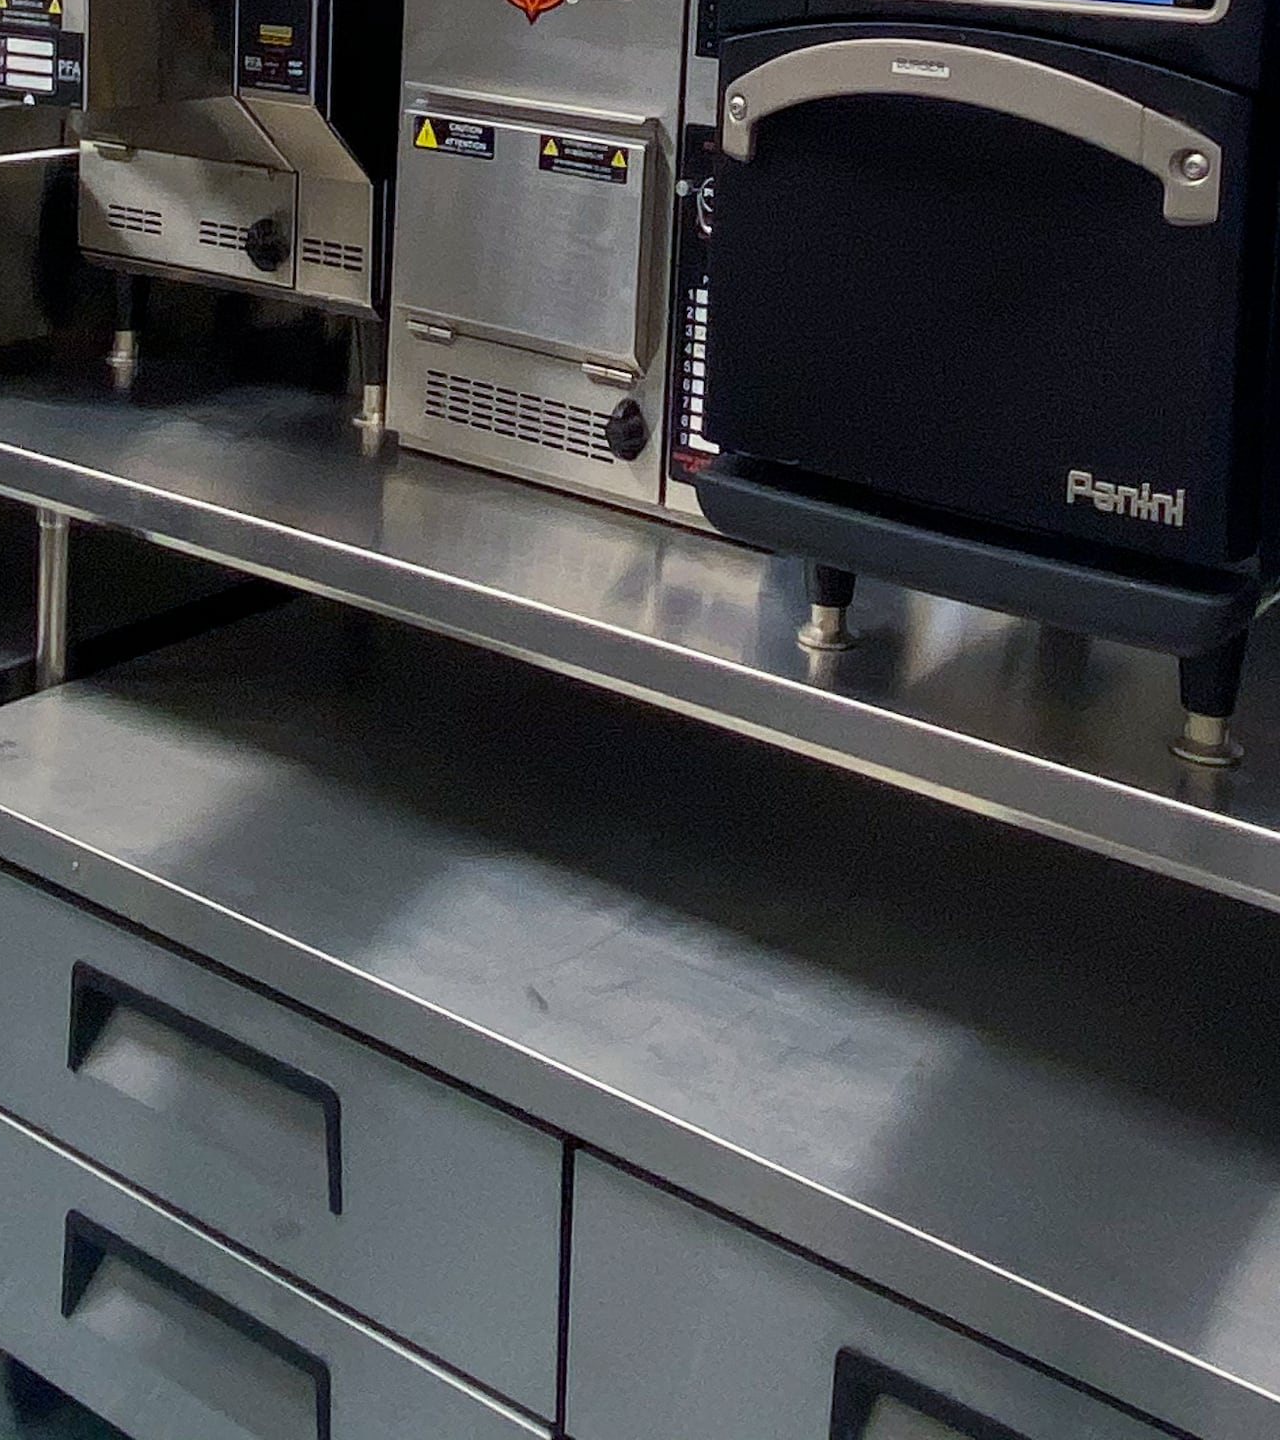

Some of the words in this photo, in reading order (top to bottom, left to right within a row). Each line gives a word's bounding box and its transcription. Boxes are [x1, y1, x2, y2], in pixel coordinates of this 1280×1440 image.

[687, 288, 694, 300] 1
[686, 305, 694, 319] 2
[685, 324, 693, 337] 3
[684, 342, 692, 354] 4
[683, 359, 691, 373] 5
[682, 395, 689, 409] 7
[1066, 469, 1186, 528] Panini
